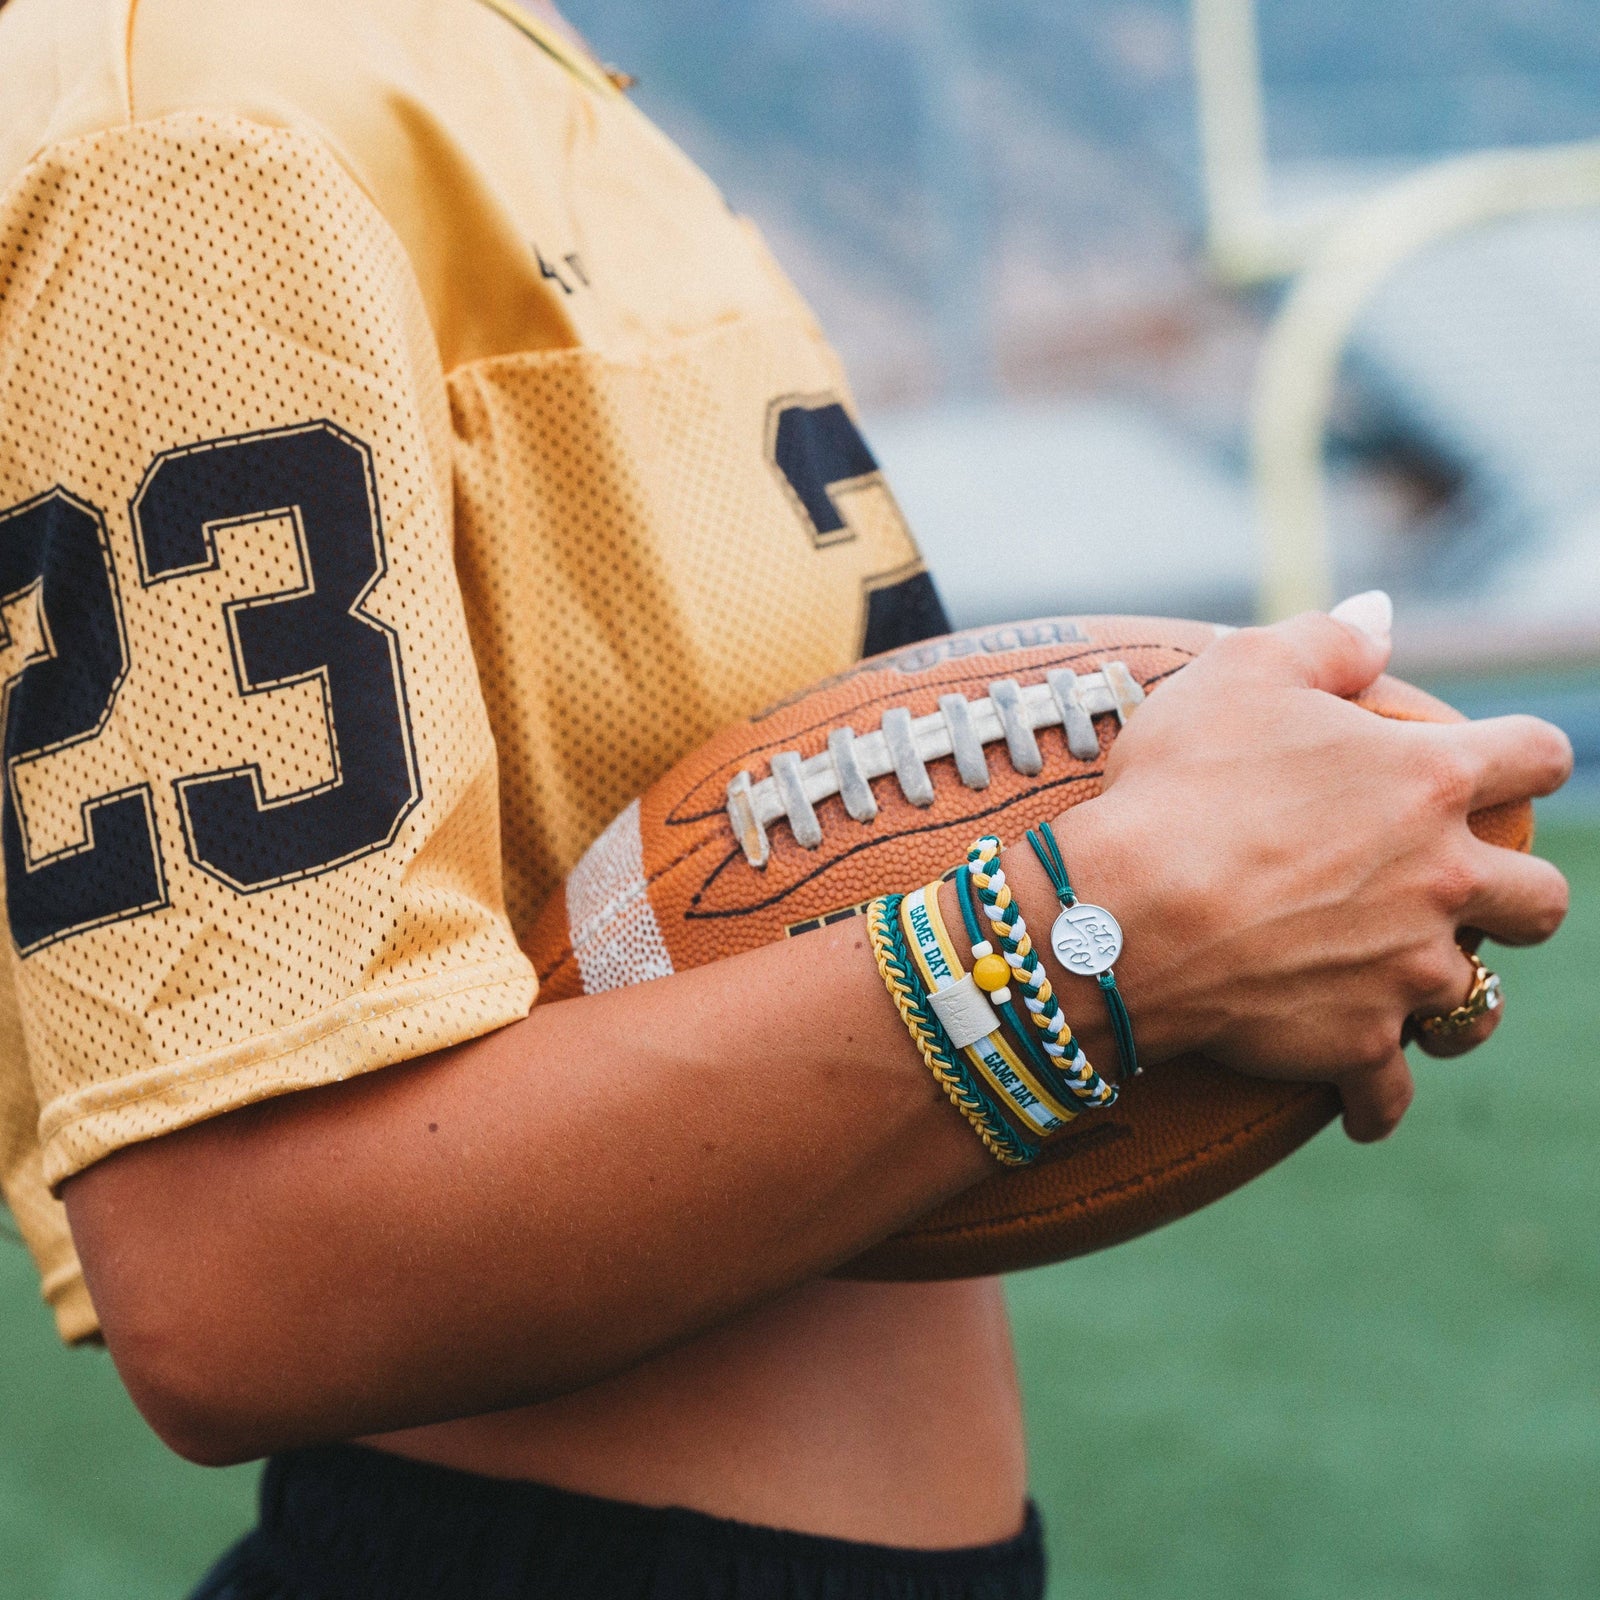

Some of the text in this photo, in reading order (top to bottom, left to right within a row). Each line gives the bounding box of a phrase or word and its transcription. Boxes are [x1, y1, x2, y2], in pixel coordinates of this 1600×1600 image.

[0, 418, 423, 961] 23
[910, 904, 952, 980] GAME DAY
[983, 1051, 1040, 1108] GAME DAY
